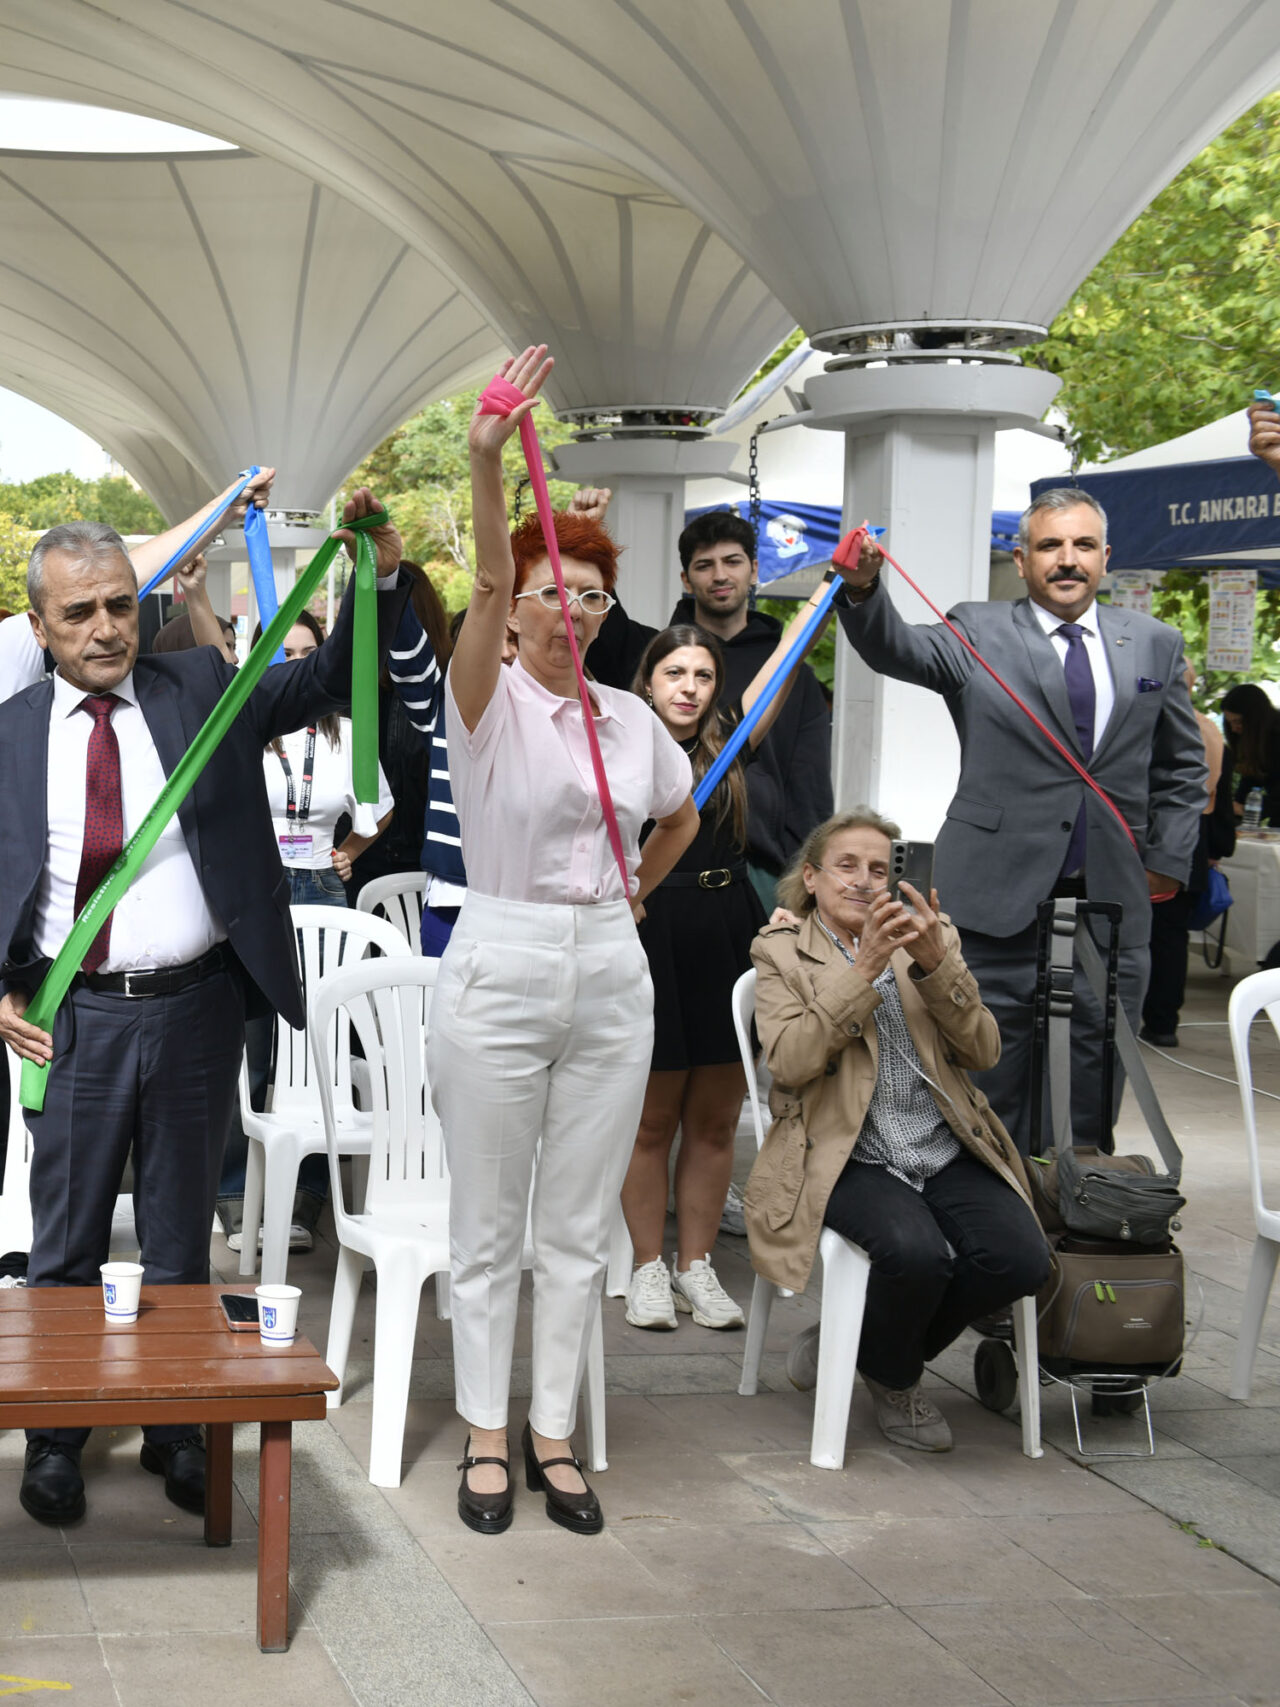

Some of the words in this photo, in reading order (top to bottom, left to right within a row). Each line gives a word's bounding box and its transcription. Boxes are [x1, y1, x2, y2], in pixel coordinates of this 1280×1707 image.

[1168, 502, 1195, 526] T.C.
[1198, 494, 1269, 524] ANKARA
[81, 872, 116, 923] Resistive
